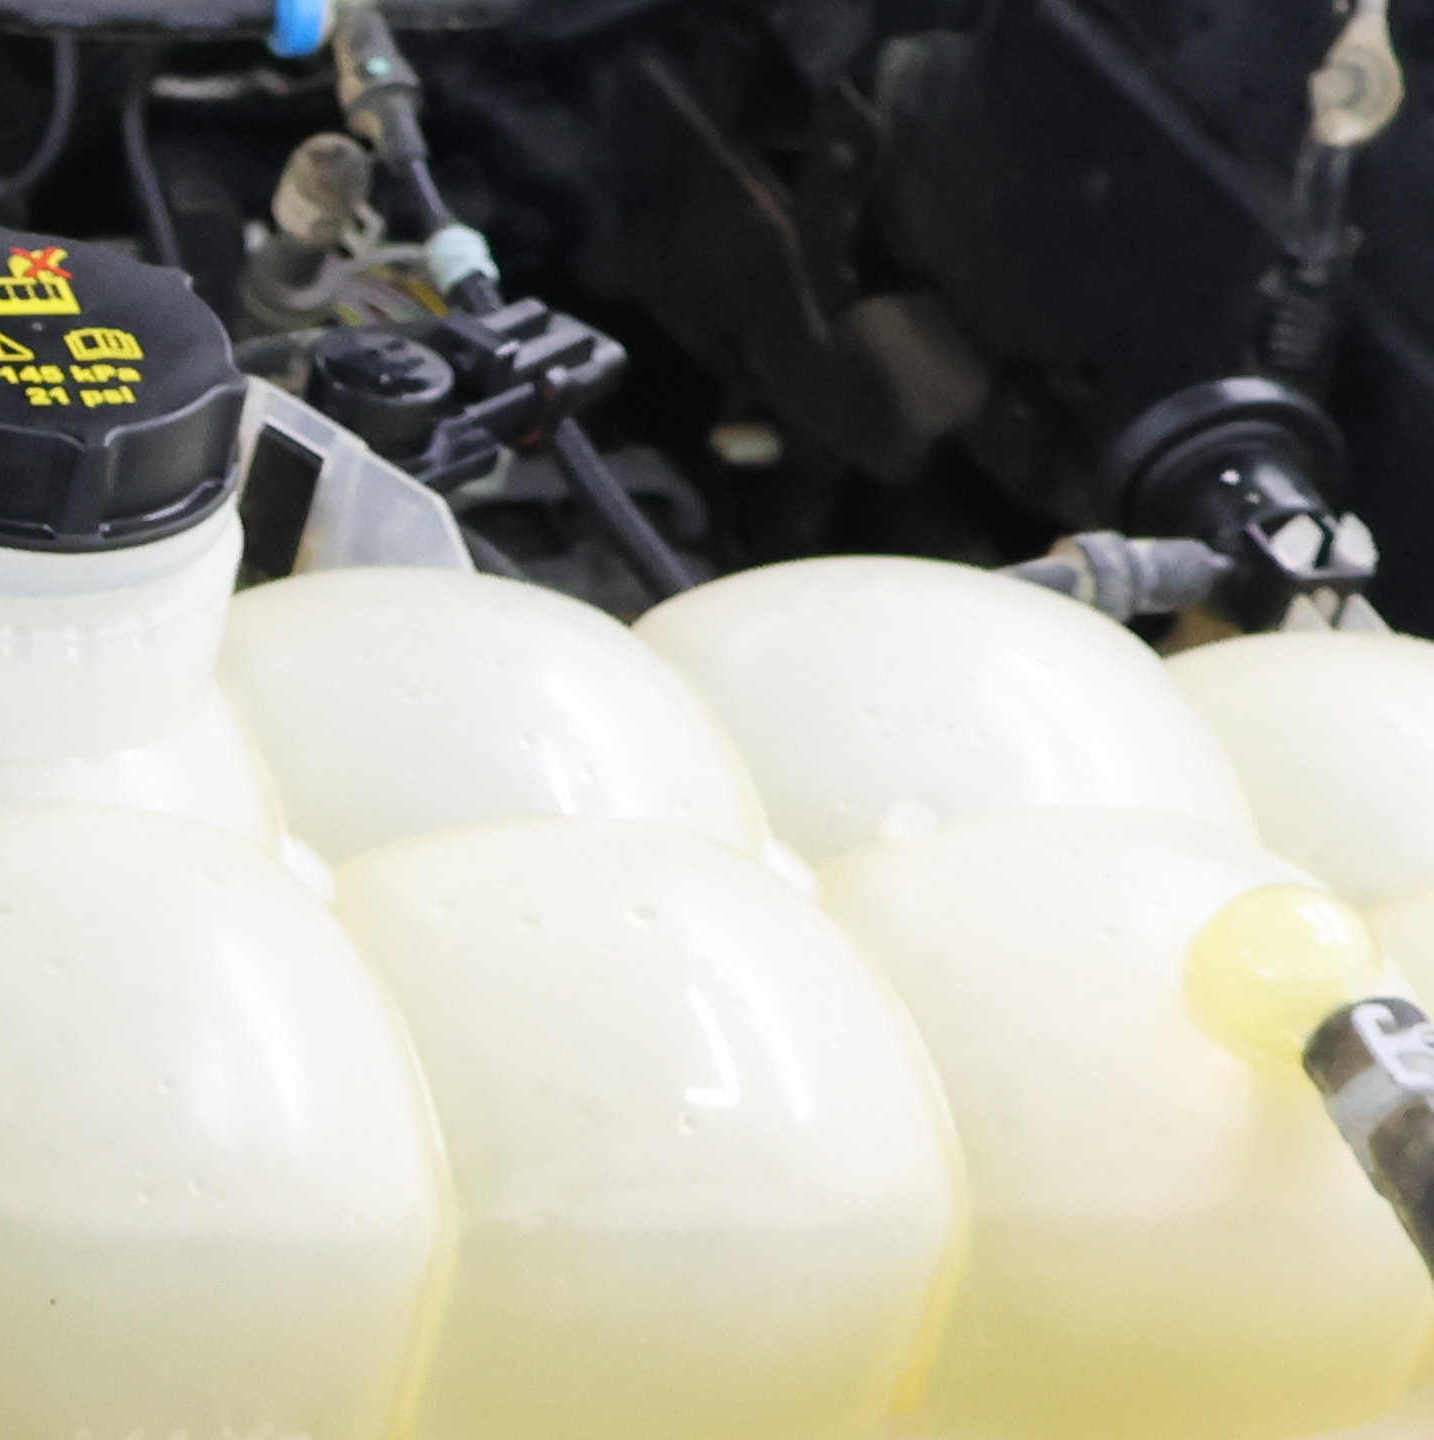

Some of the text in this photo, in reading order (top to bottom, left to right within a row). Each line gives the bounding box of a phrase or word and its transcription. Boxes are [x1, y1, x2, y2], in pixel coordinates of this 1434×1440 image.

[69, 364, 142, 384] kPa
[25, 385, 137, 408] 21 psi
